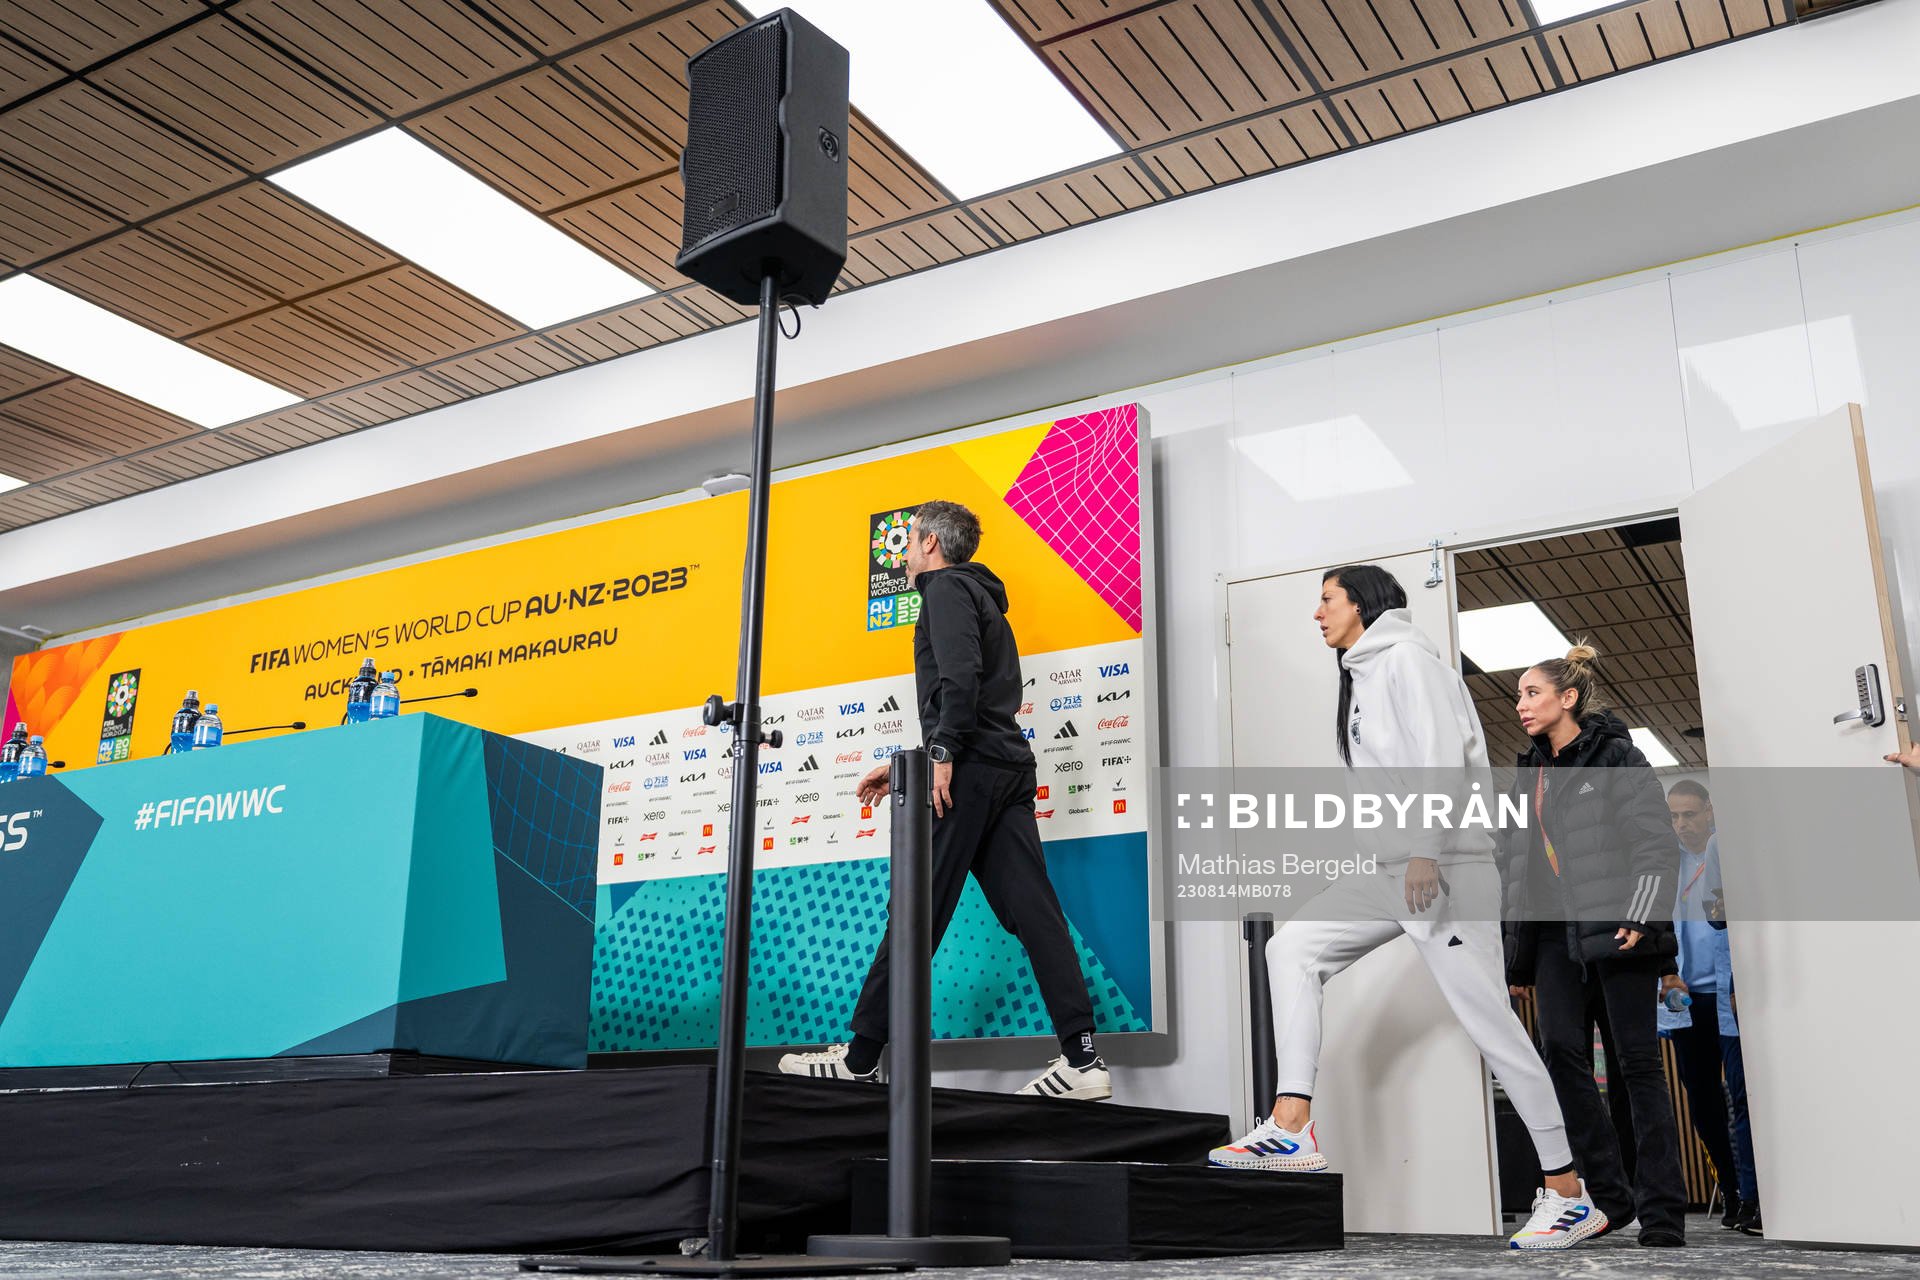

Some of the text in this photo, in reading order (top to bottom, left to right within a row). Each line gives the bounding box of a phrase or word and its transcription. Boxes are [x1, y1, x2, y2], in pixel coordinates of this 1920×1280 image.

[871, 572, 889, 582] FIFA
[871, 577, 906, 590] WOMEN'S
[871, 586, 897, 597] WORLD
[870, 599, 893, 615] AU
[898, 595, 921, 610] 20
[870, 613, 893, 628] NZ
[898, 608, 920, 624] 23
[250, 648, 290, 673] FIFA
[294, 627, 389, 664] WOMEN'S
[395, 610, 472, 644] WORLD
[476, 600, 522, 627] CUP
[304, 668, 402, 701] AUCKD
[421, 651, 492, 679] TĀMAKI
[498, 627, 618, 666] MAKAURAU
[1097, 663, 1130, 678] VISA
[1050, 669, 1082, 682] QATAR
[1058, 678, 1082, 686] AIRWAYS
[797, 706, 824, 720] QATAR
[838, 702, 865, 716] VISA
[874, 720, 903, 732] QATAR
[1020, 727, 1036, 740] SA
[613, 736, 635, 748] VISA
[645, 752, 670, 764] QATAR
[683, 748, 707, 761] VISA
[718, 767, 733, 776] QAT
[758, 761, 783, 774] VISA
[1054, 760, 1083, 773] xero
[795, 792, 819, 804] xero
[135, 784, 286, 830] #FIFAWWC
[717, 802, 731, 813] xe
[643, 810, 666, 821] xero
